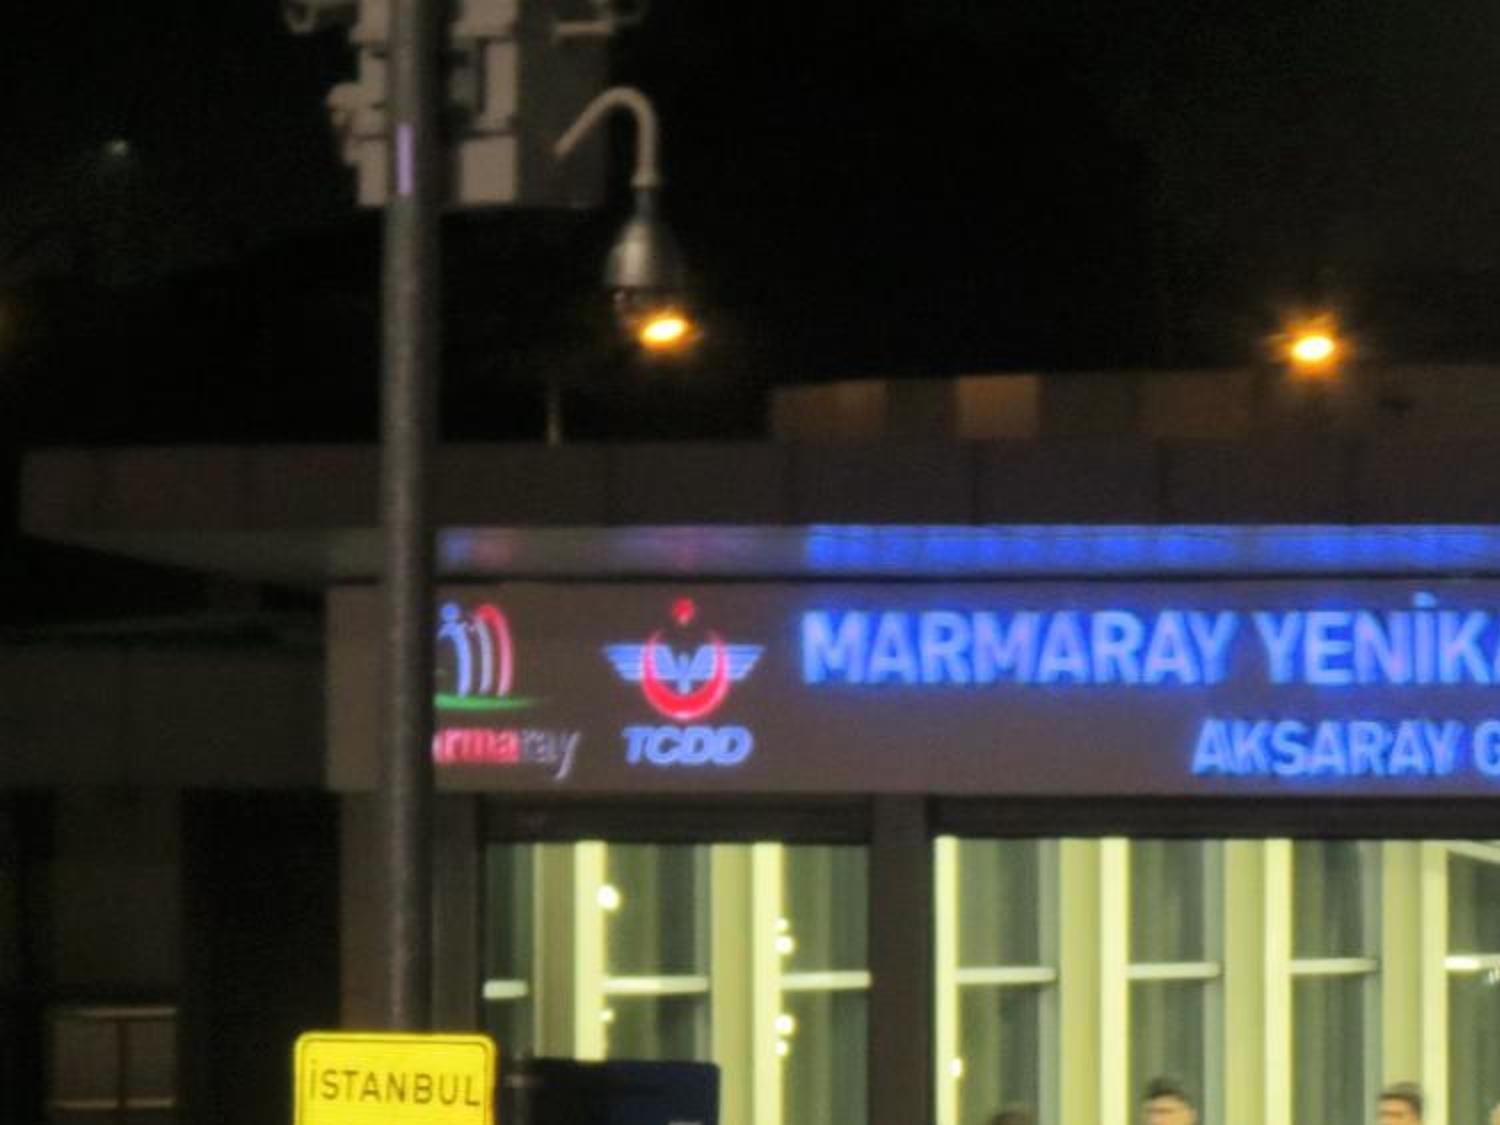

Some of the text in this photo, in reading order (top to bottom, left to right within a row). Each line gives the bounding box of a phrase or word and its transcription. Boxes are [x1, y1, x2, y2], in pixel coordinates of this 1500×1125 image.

[802, 610, 1238, 685] MARMARAY
[621, 725, 755, 766] TCDD
[1192, 717, 1464, 777] AKSARAY
[308, 1060, 482, 1108] İSTANBUL
